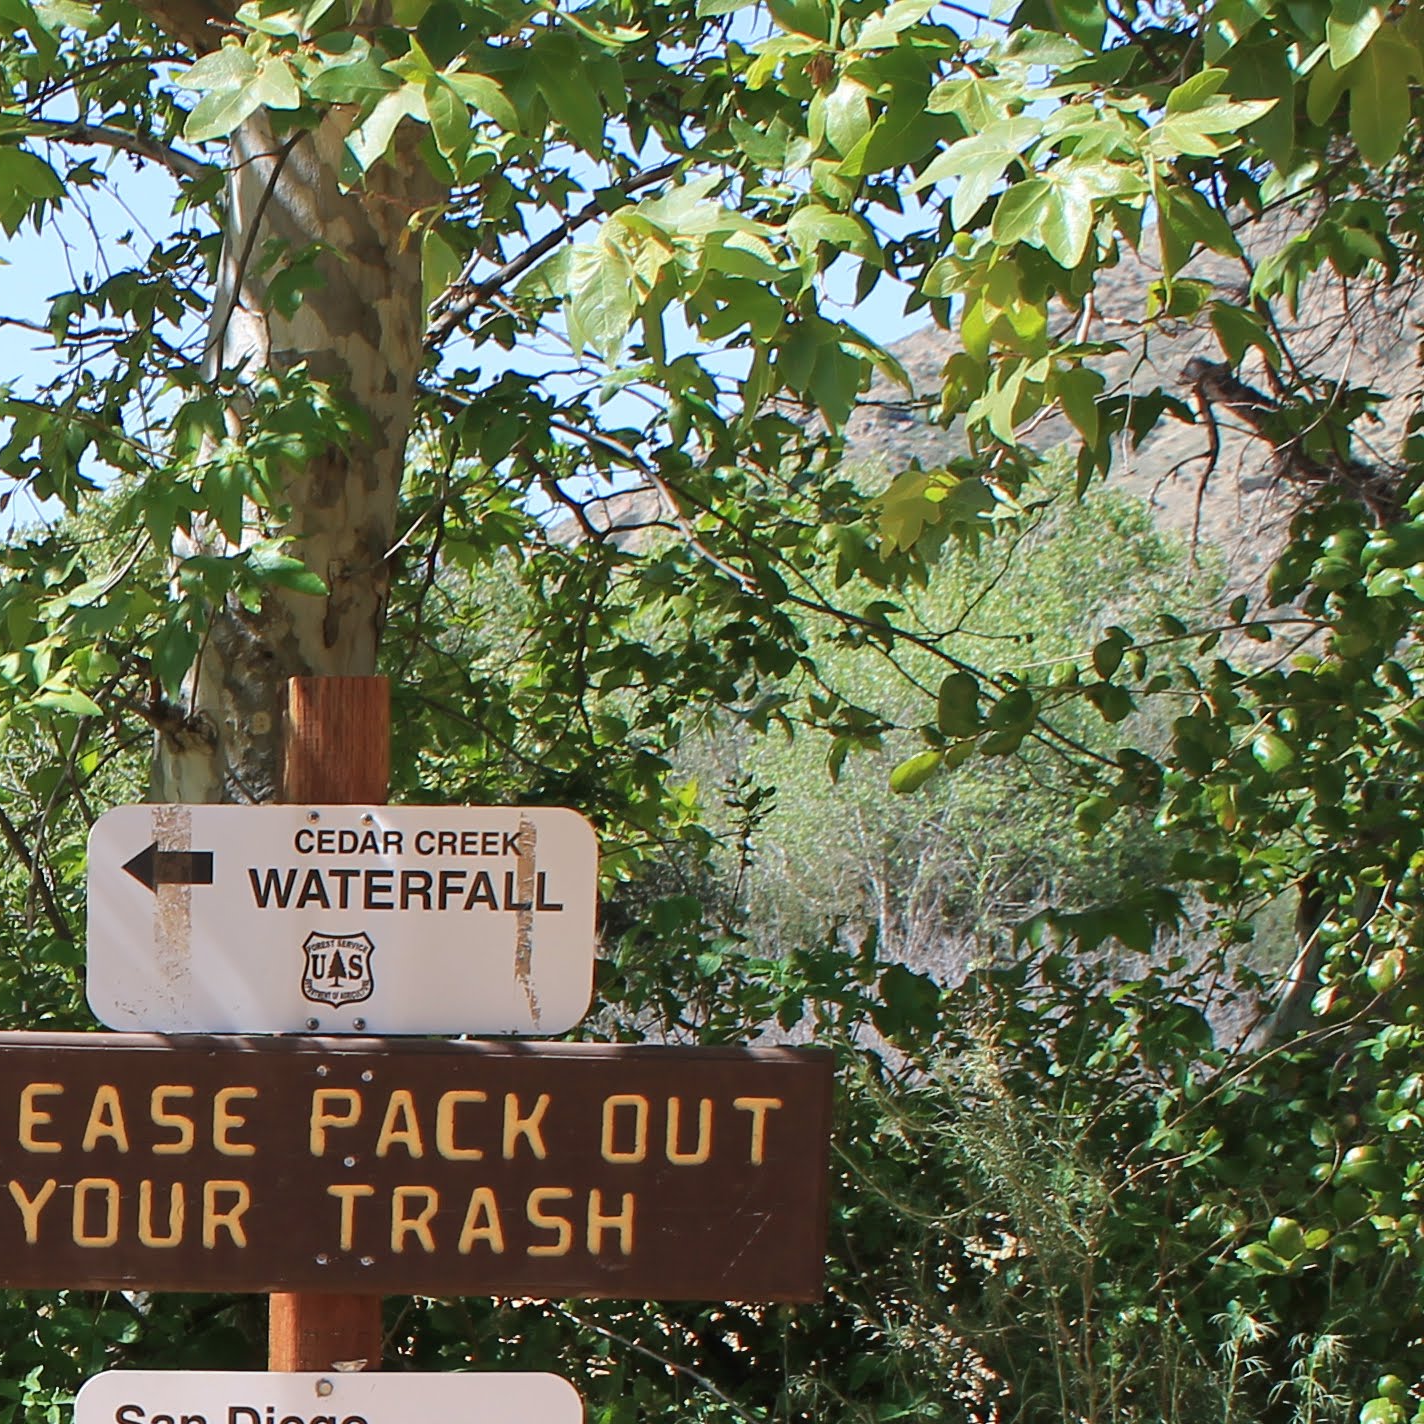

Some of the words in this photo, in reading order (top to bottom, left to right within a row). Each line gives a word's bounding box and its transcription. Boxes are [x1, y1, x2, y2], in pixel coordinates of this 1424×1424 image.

[294, 829, 403, 856] CEDAR
[415, 831, 522, 857] CREEK
[249, 868, 563, 912] WATERFALL
[307, 940, 334, 953] FOREST
[337, 940, 368, 953] SERVICE
[310, 1088, 550, 1163] PACK
[601, 1094, 782, 1166] OUT
[9, 1178, 250, 1249] YOUR
[327, 1184, 635, 1257] TRASH
